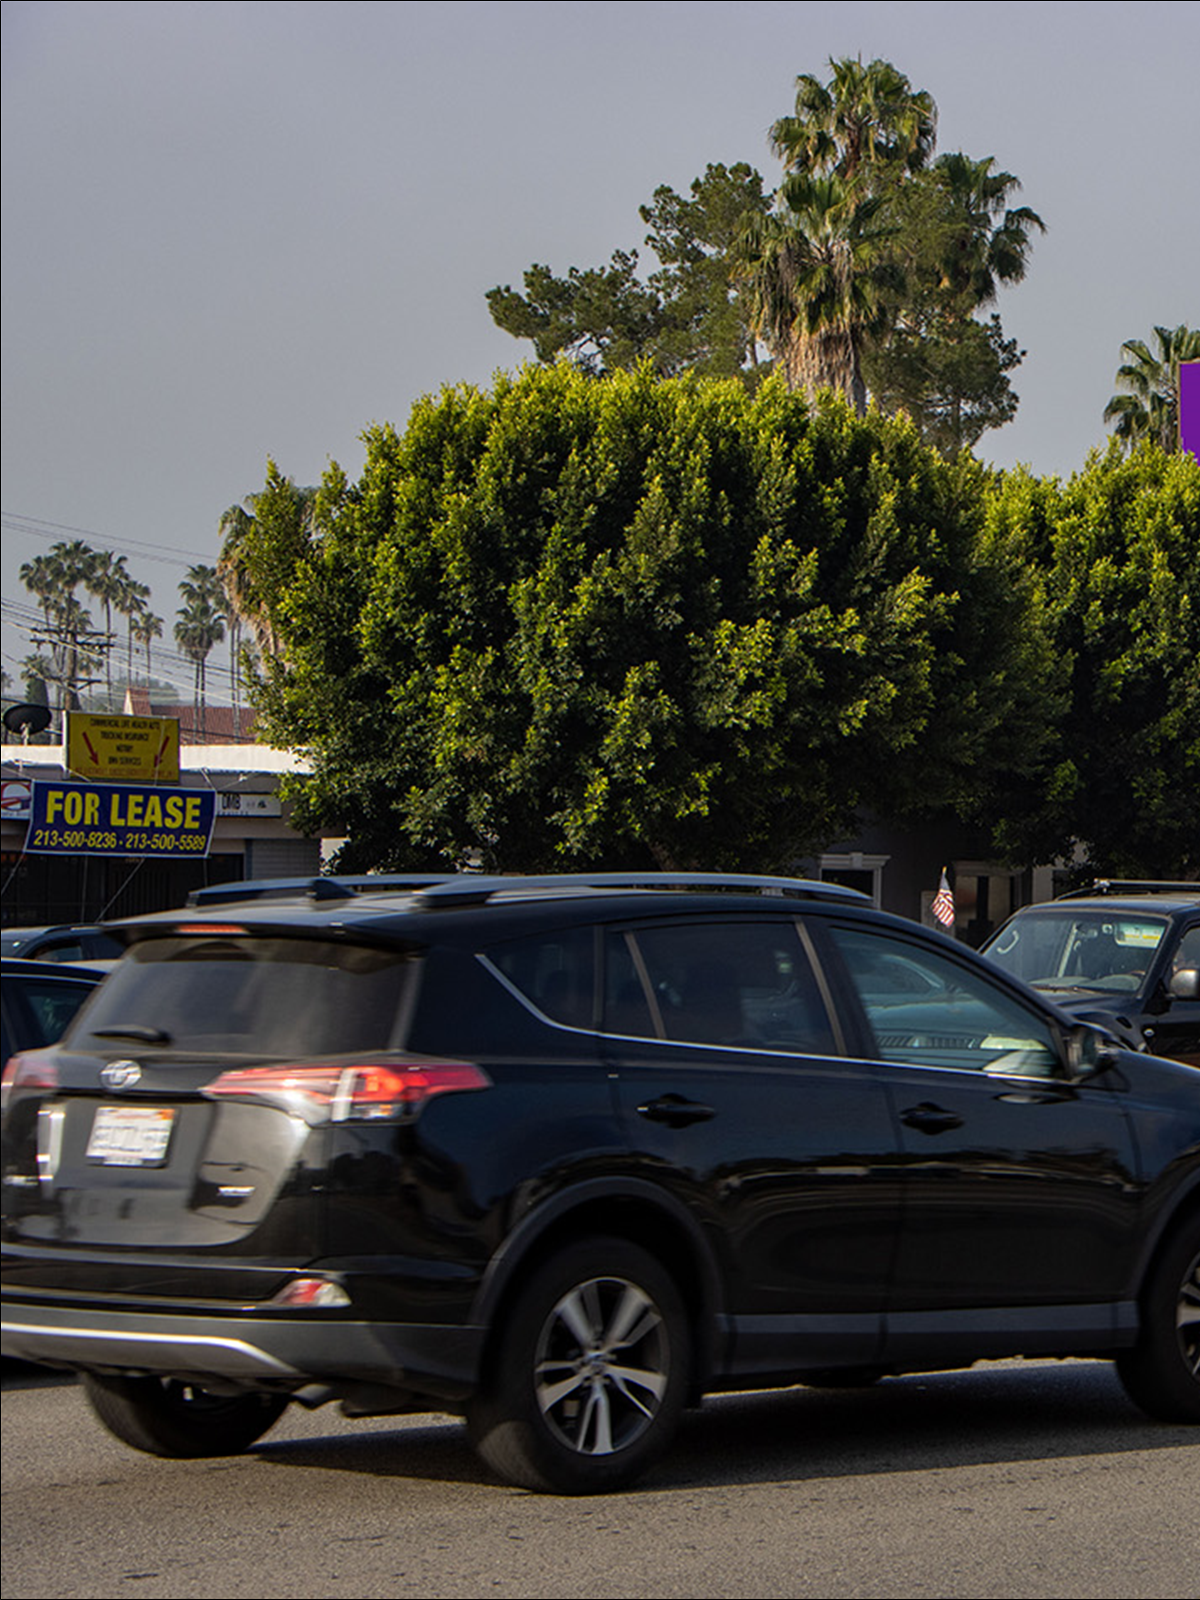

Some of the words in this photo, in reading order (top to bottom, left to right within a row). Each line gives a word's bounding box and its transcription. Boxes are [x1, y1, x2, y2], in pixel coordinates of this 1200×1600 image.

[46, 791, 100, 825] FOR
[110, 794, 201, 829] LEASE
[33, 830, 117, 848] 213-500-8236
[125, 833, 206, 850] 213-500-5589
